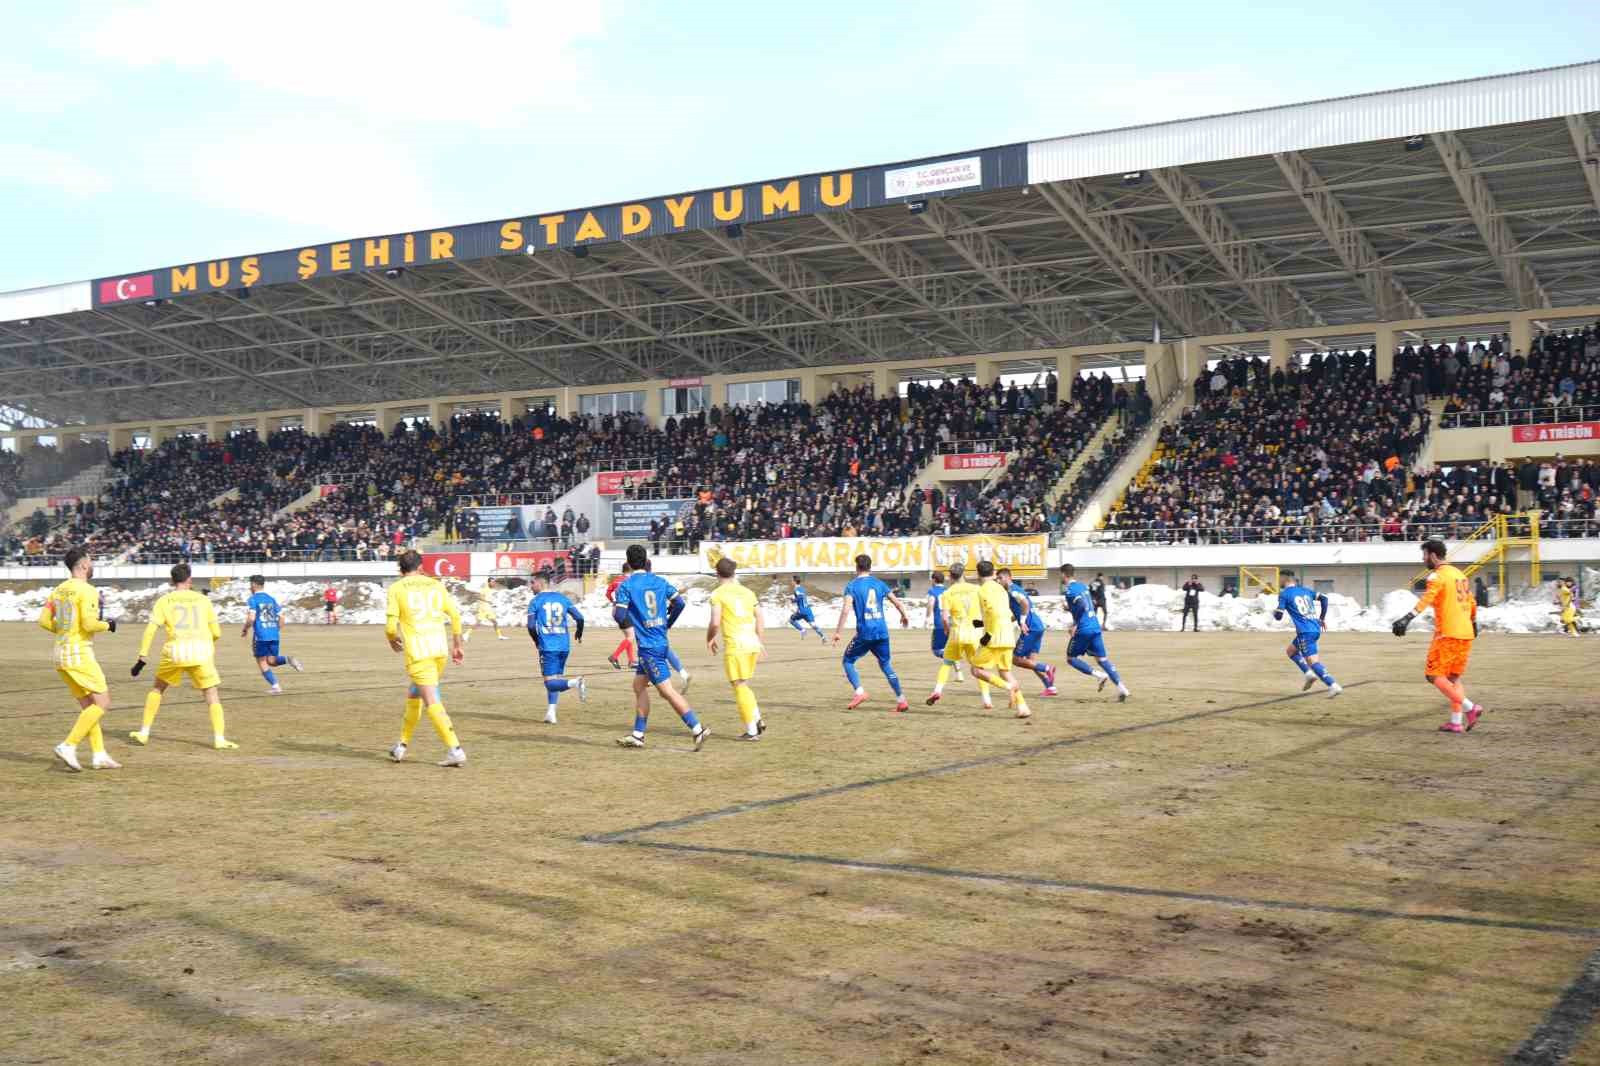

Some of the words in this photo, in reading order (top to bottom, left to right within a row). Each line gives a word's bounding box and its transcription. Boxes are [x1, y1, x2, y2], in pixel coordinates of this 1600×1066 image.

[171, 257, 261, 293] MUŞ
[297, 231, 454, 280] ŞEHİR
[500, 173, 853, 251] STADYUMU
[1539, 429, 1548, 440] A
[1549, 424, 1592, 440] TRİBÜN
[644, 590, 657, 619] 9
[866, 588, 878, 611] 4
[174, 605, 199, 629] 21
[543, 601, 563, 626] 13
